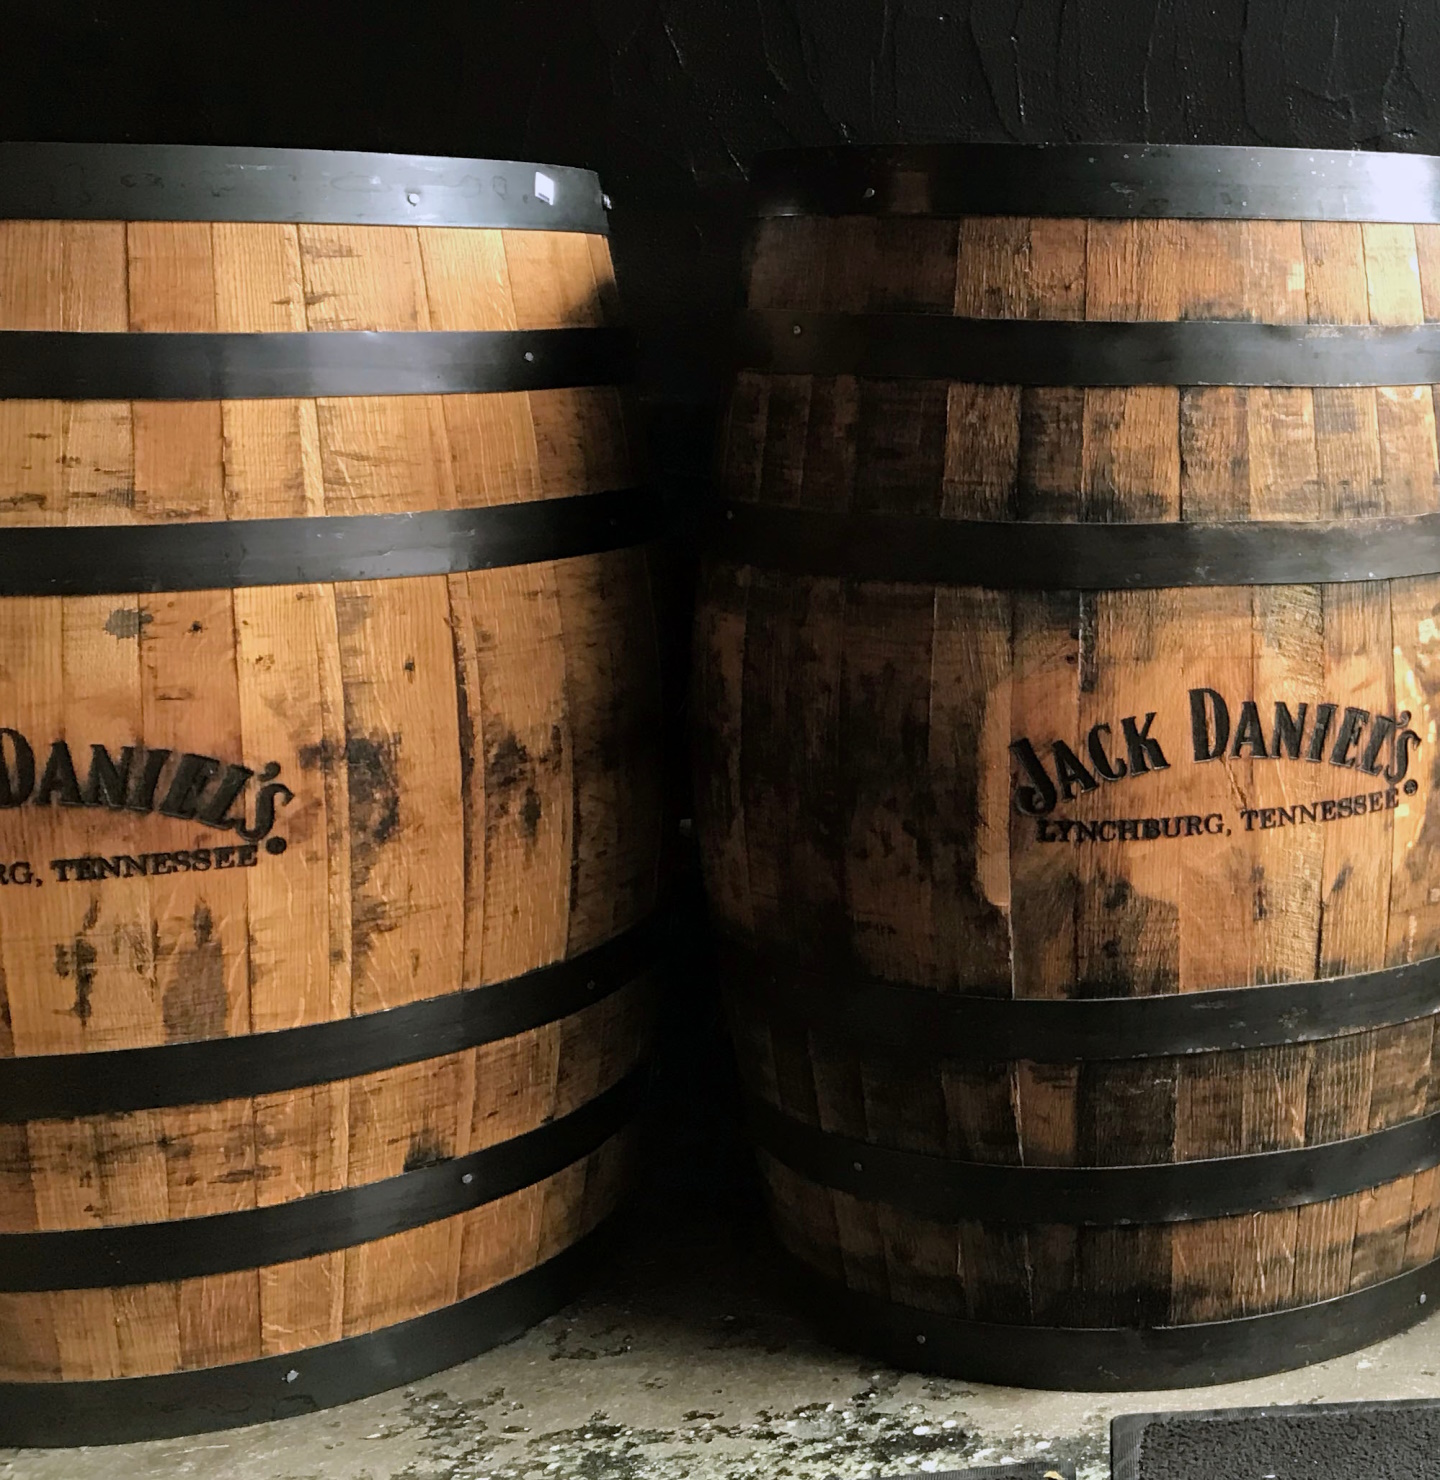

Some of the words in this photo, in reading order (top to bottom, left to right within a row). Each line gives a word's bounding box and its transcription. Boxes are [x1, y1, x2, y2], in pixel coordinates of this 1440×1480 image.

[1008, 711, 1171, 817] JACK
[1188, 687, 1423, 784] DANIEL'S
[1036, 812, 1233, 843] LYNCHBURG,
[1240, 787, 1400, 832] TENNESSEE
[49, 844, 258, 883] TENNESSEE
